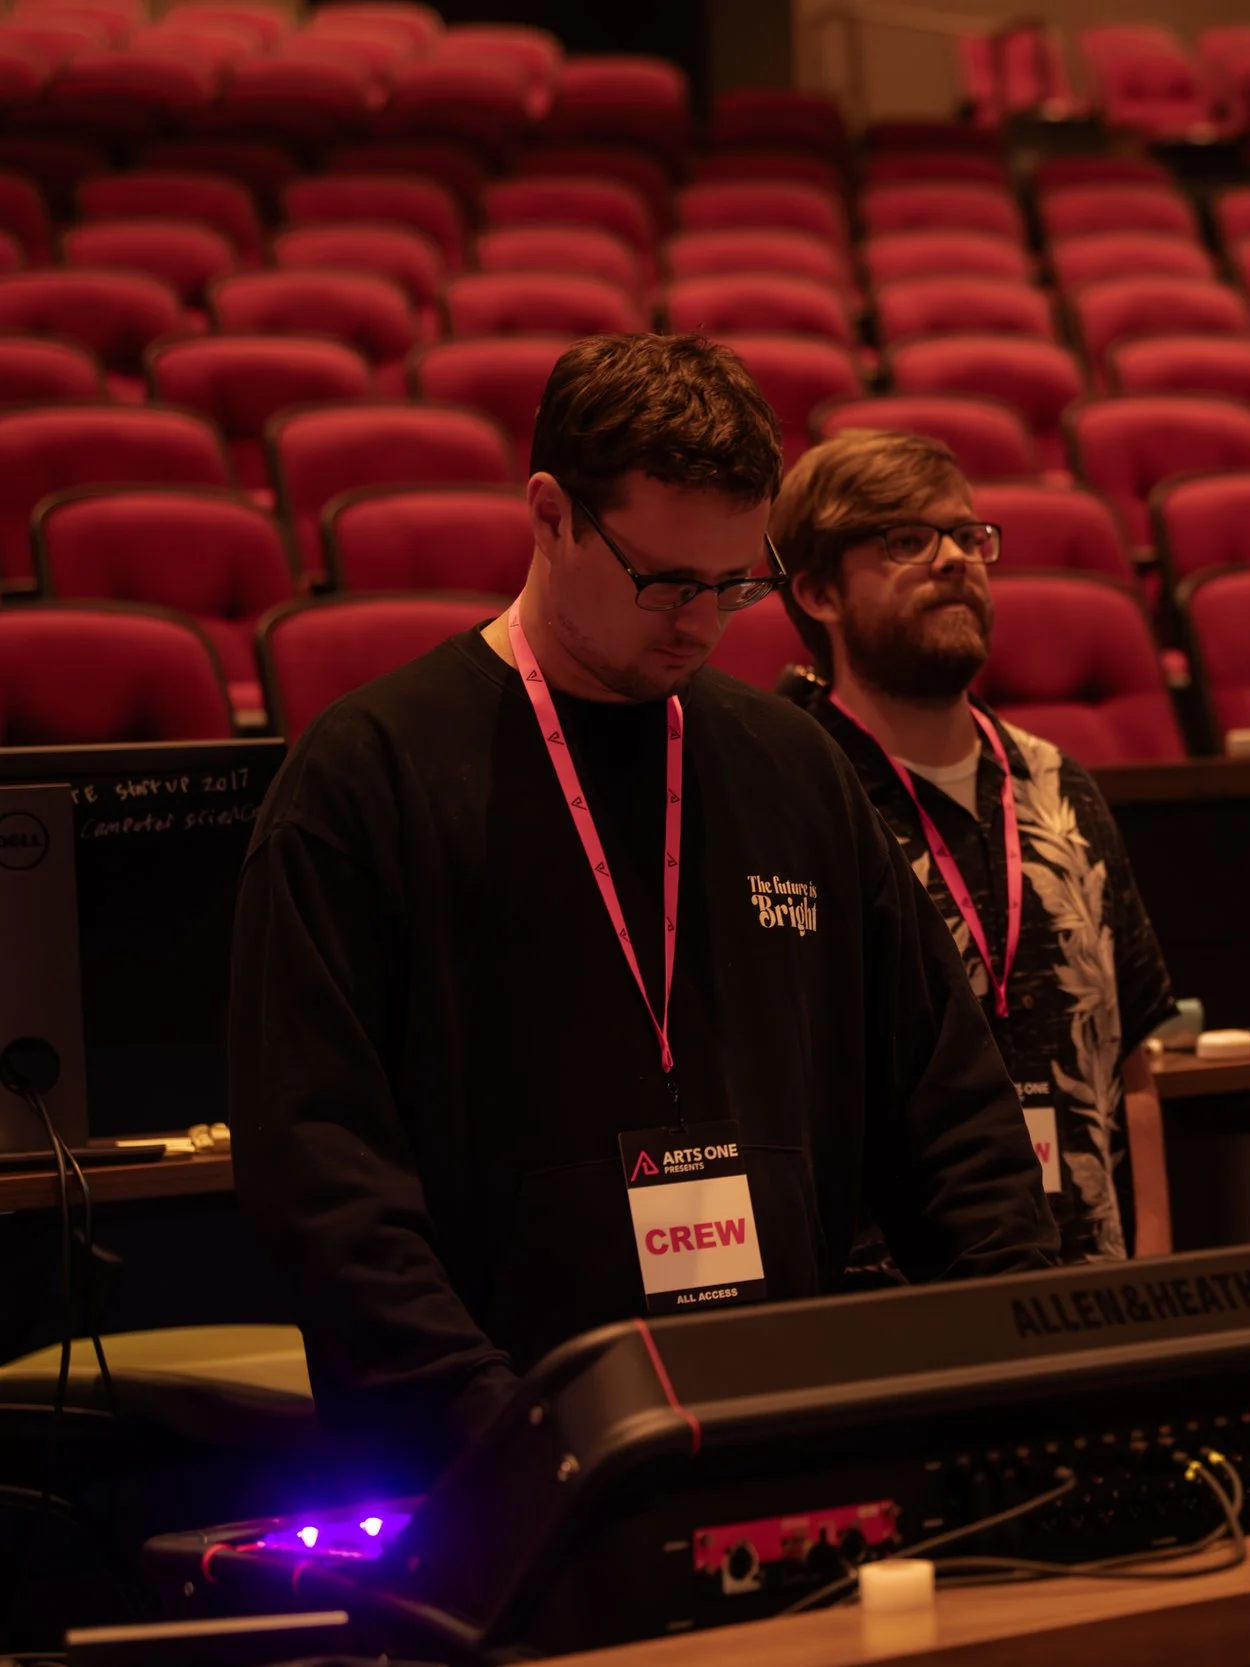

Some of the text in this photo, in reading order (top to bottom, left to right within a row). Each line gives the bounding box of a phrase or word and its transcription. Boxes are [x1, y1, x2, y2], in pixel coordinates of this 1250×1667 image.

[202, 767, 249, 792] 2017
[746, 874, 772, 893] The
[808, 880, 818, 899] is
[750, 893, 817, 937] Bright
[662, 1143, 739, 1166] ARTS ONE
[664, 1162, 705, 1175] PRESENTS
[645, 1217, 746, 1256] CREW
[677, 1287, 739, 1305] ALL ACCESS
